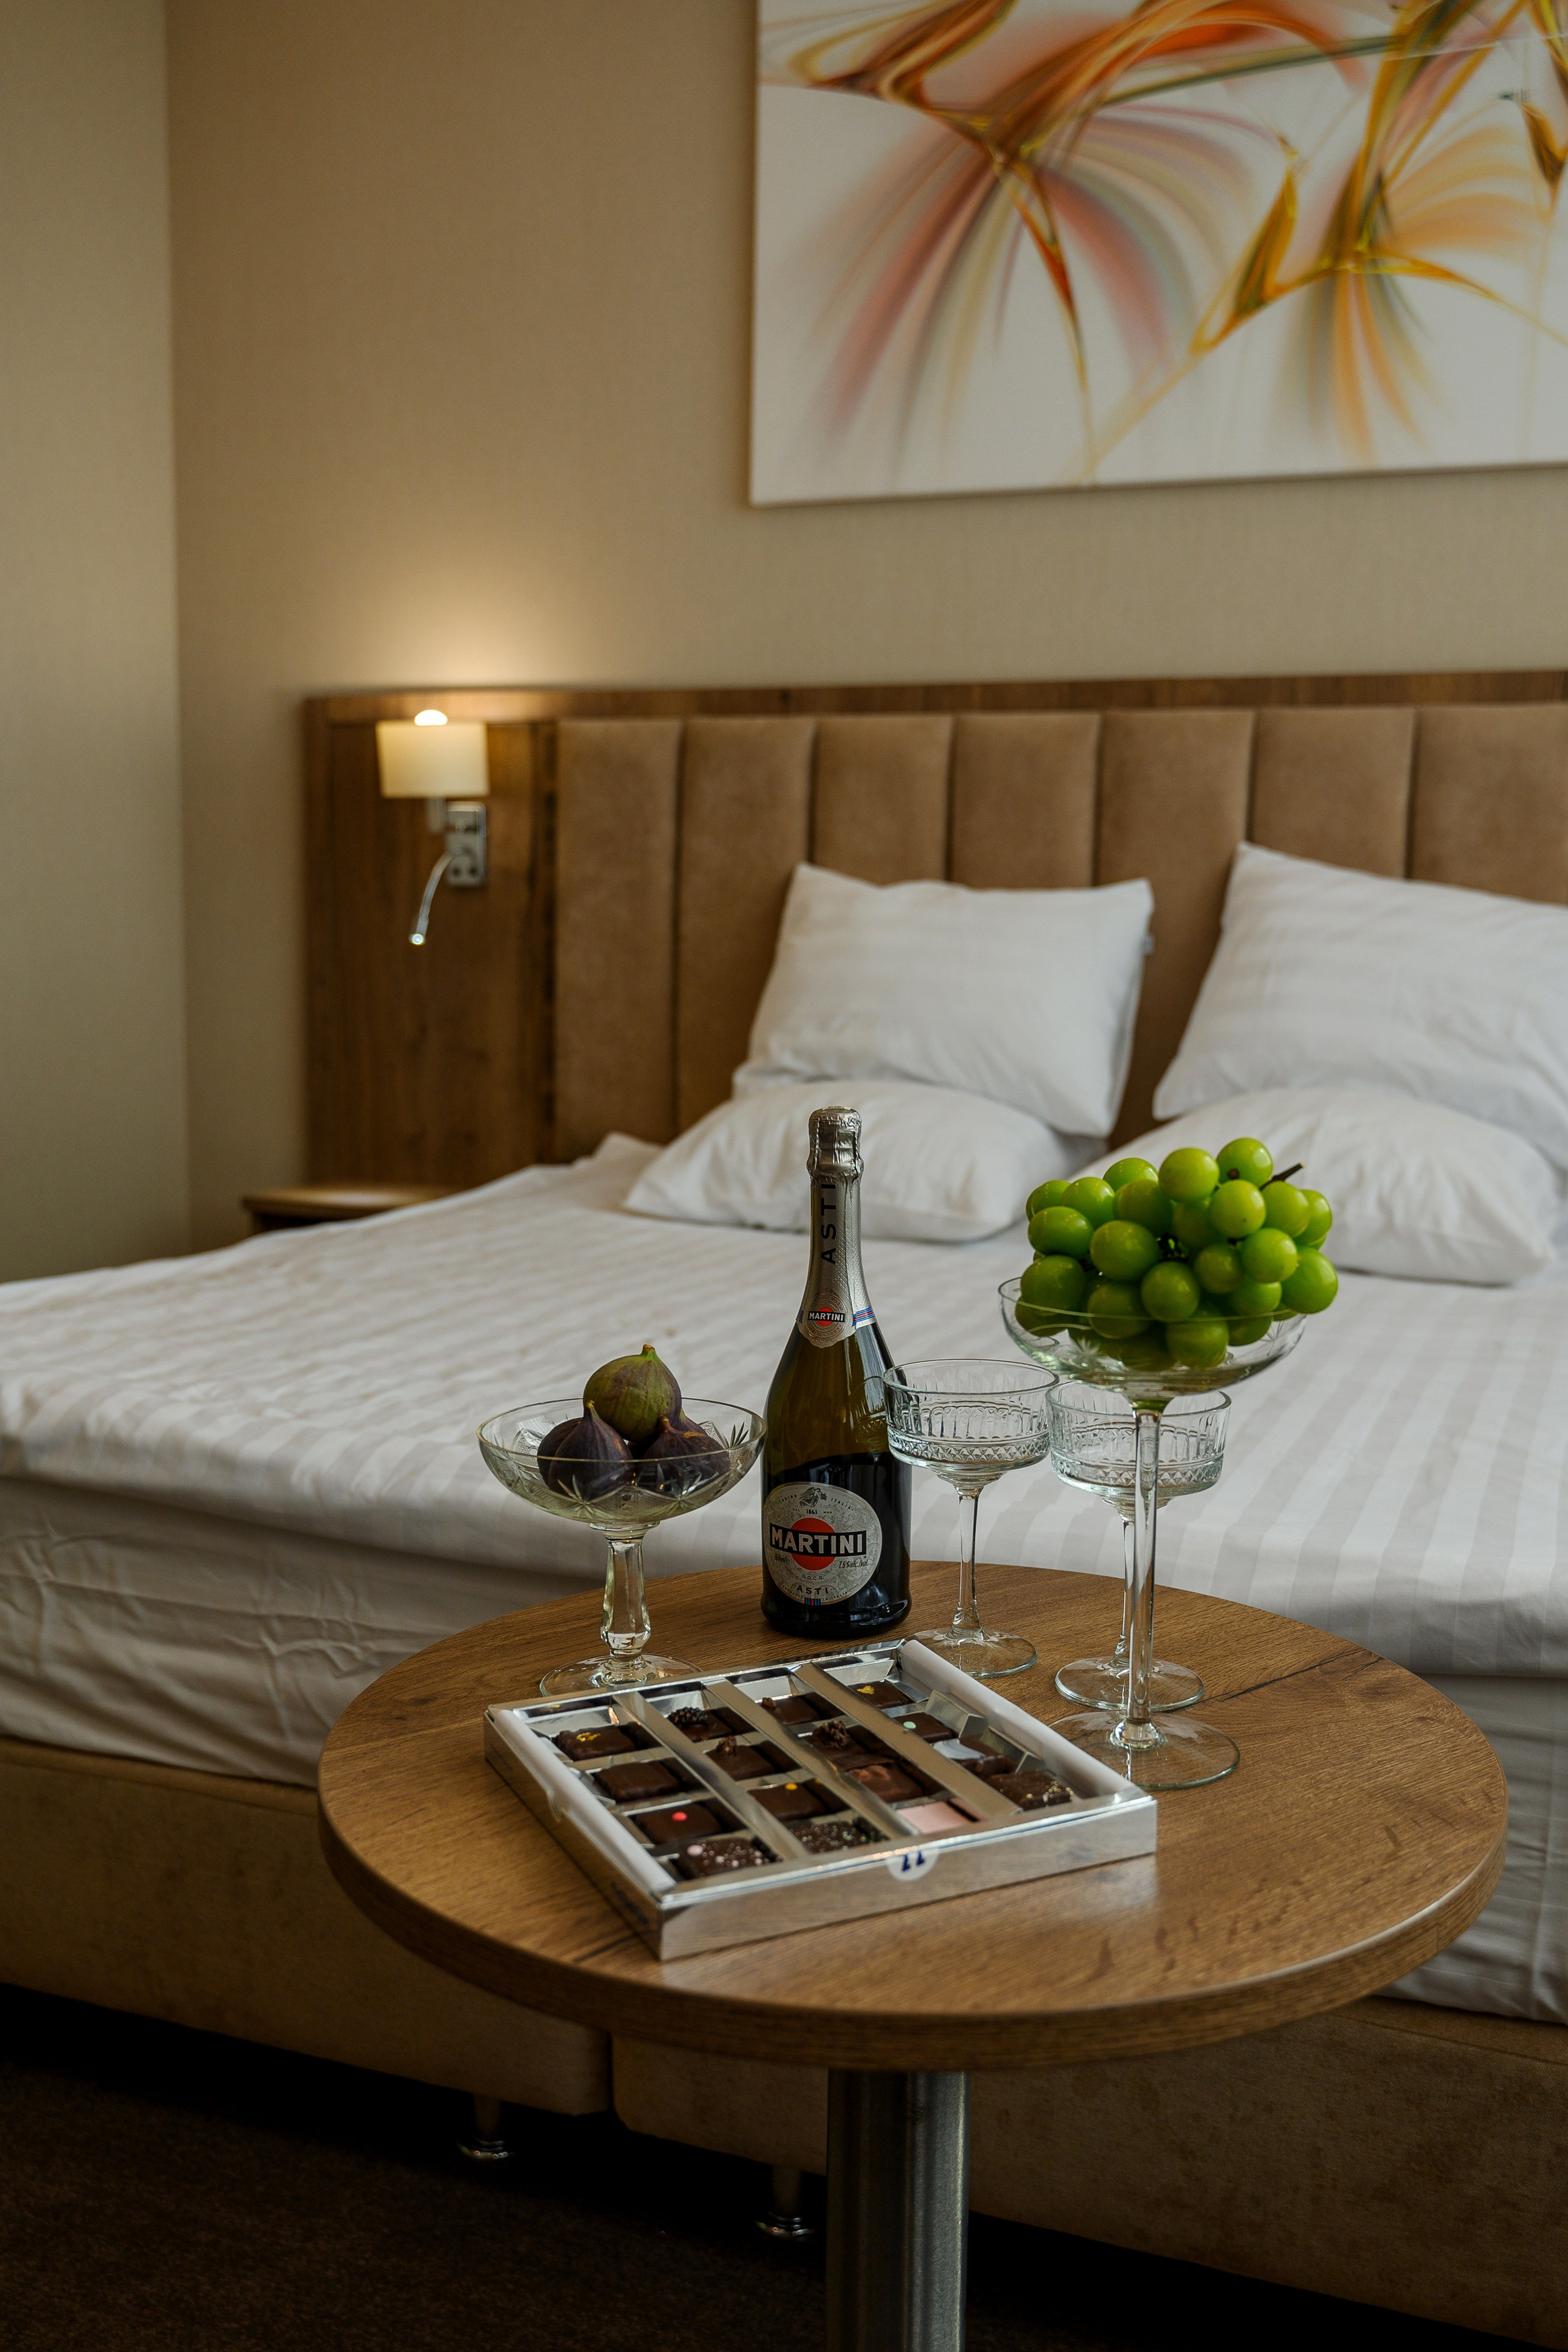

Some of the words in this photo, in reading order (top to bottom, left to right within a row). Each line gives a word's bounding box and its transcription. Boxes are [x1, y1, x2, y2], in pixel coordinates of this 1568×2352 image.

[821, 1184, 836, 1264] ASTI
[809, 1312, 844, 1322] MARTINI
[772, 1526, 862, 1555] MARTINI
[796, 1585, 829, 1595] ASTI
